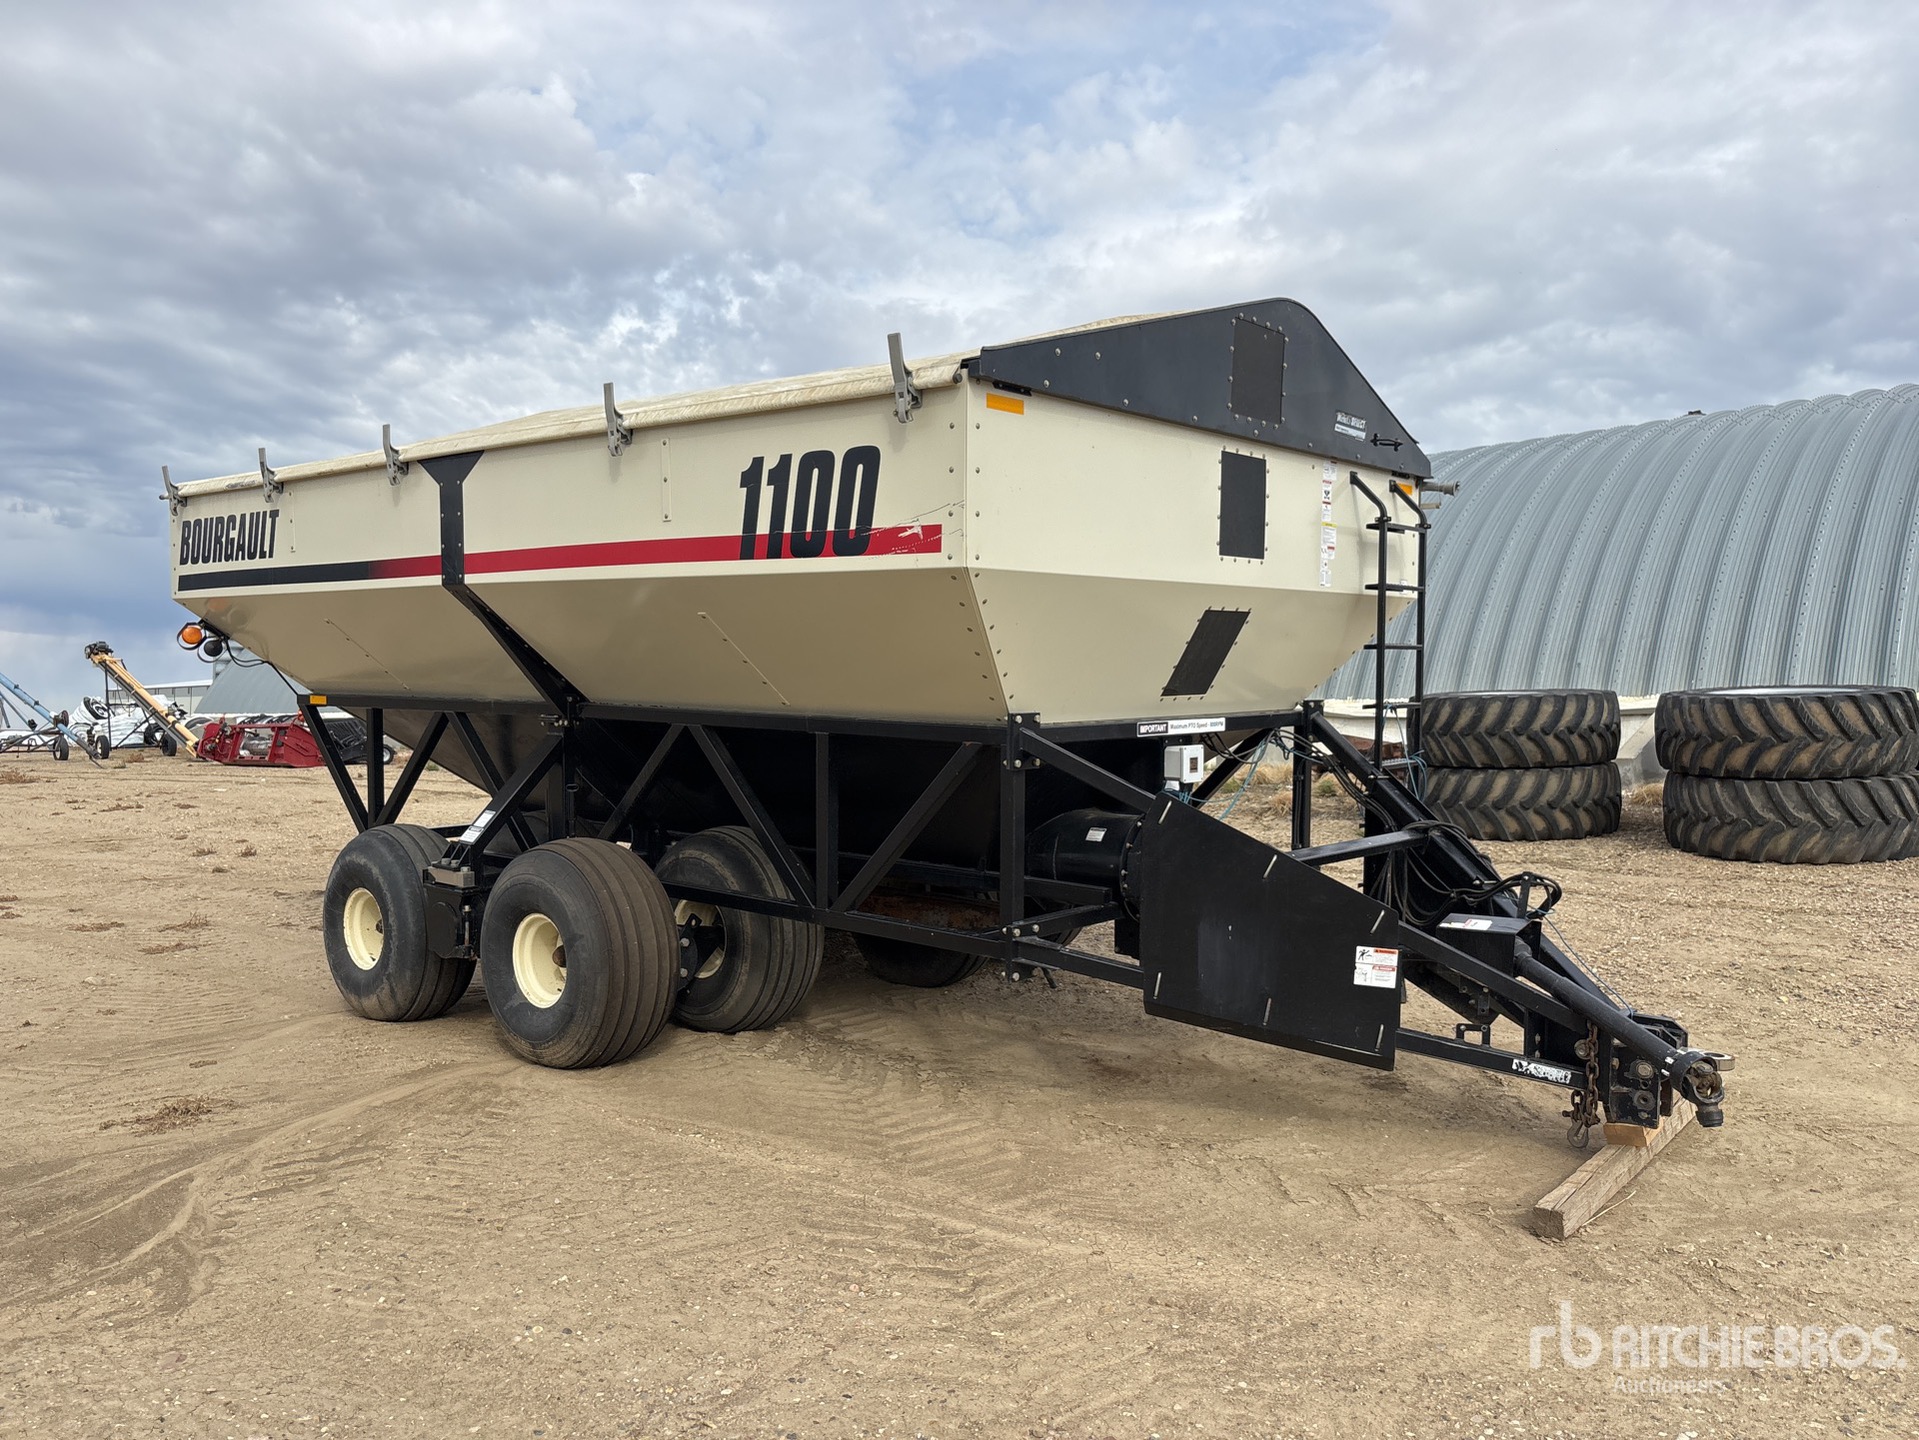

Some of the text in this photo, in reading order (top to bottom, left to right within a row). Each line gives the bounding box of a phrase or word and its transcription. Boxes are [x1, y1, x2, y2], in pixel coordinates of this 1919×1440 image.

[739, 445, 881, 560] 1100
[179, 509, 280, 566] BOURGAULT
[1139, 723, 1167, 734] IMPORTANT
